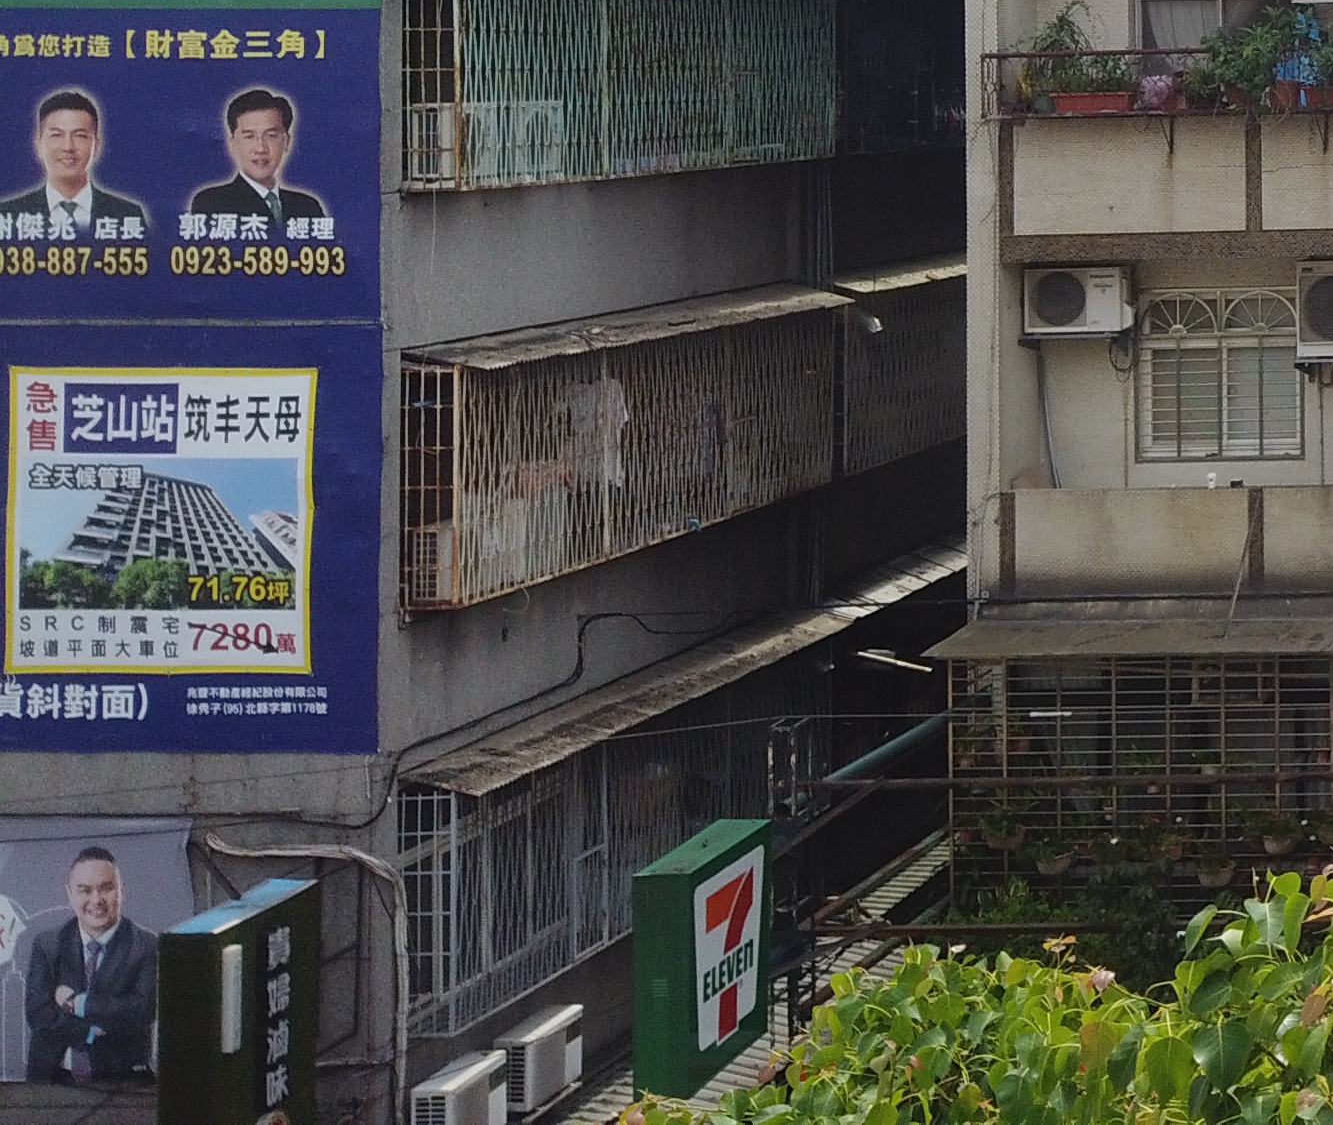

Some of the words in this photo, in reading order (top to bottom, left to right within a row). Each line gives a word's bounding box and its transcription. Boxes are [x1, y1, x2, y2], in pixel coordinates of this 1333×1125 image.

[95, 216, 145, 241] 店長
[179, 213, 269, 241] 郭源杰
[286, 217, 335, 241] 經理
[170, 246, 346, 276] 0923-589-993
[26, 381, 58, 452] 急售
[71, 393, 175, 443] 芝山站
[29, 463, 144, 490] 全天候管理
[187, 574, 291, 604] 71.76坪
